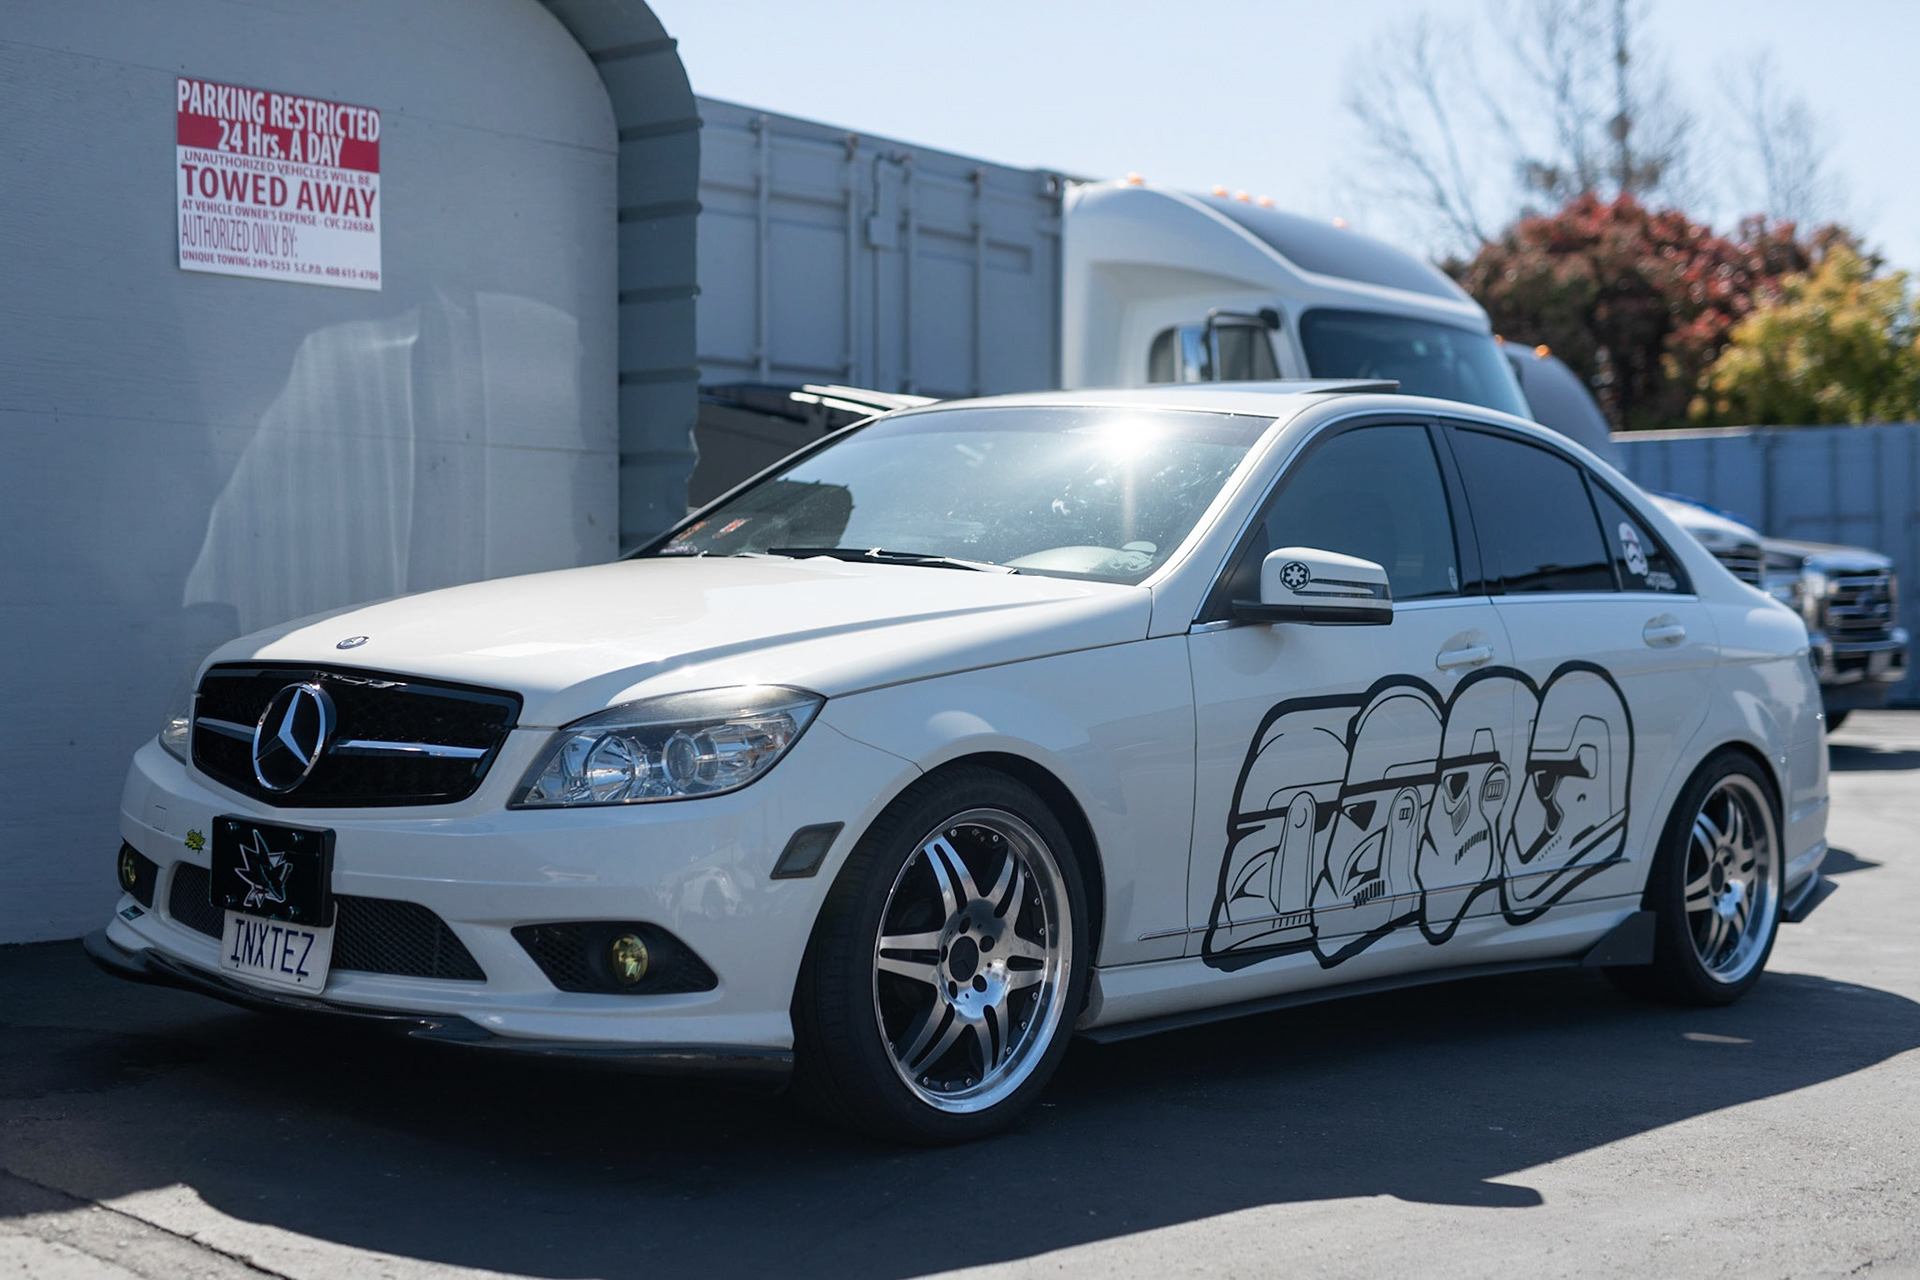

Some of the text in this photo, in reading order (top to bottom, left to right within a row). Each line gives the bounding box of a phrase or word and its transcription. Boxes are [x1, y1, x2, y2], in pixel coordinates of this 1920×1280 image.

[178, 79, 380, 142] PARKING RESTRICTED
[217, 119, 344, 168] 24 Hrs. A DAY
[182, 164, 375, 218] TOWED AWAY
[184, 149, 371, 186] UNAUTHORIZED VEHICLES WILL BE
[182, 199, 194, 211] AT
[195, 200, 233, 216] VEHICLE
[234, 205, 277, 222] OWNER'S
[278, 211, 317, 227] EXPENSE
[323, 219, 341, 231] CVC
[182, 213, 299, 259] AUTHORIZED ONLY BY:
[182, 250, 215, 265] UNIQUE
[216, 253, 251, 268] TOWING
[230, 918, 315, 977] INXTEZ
